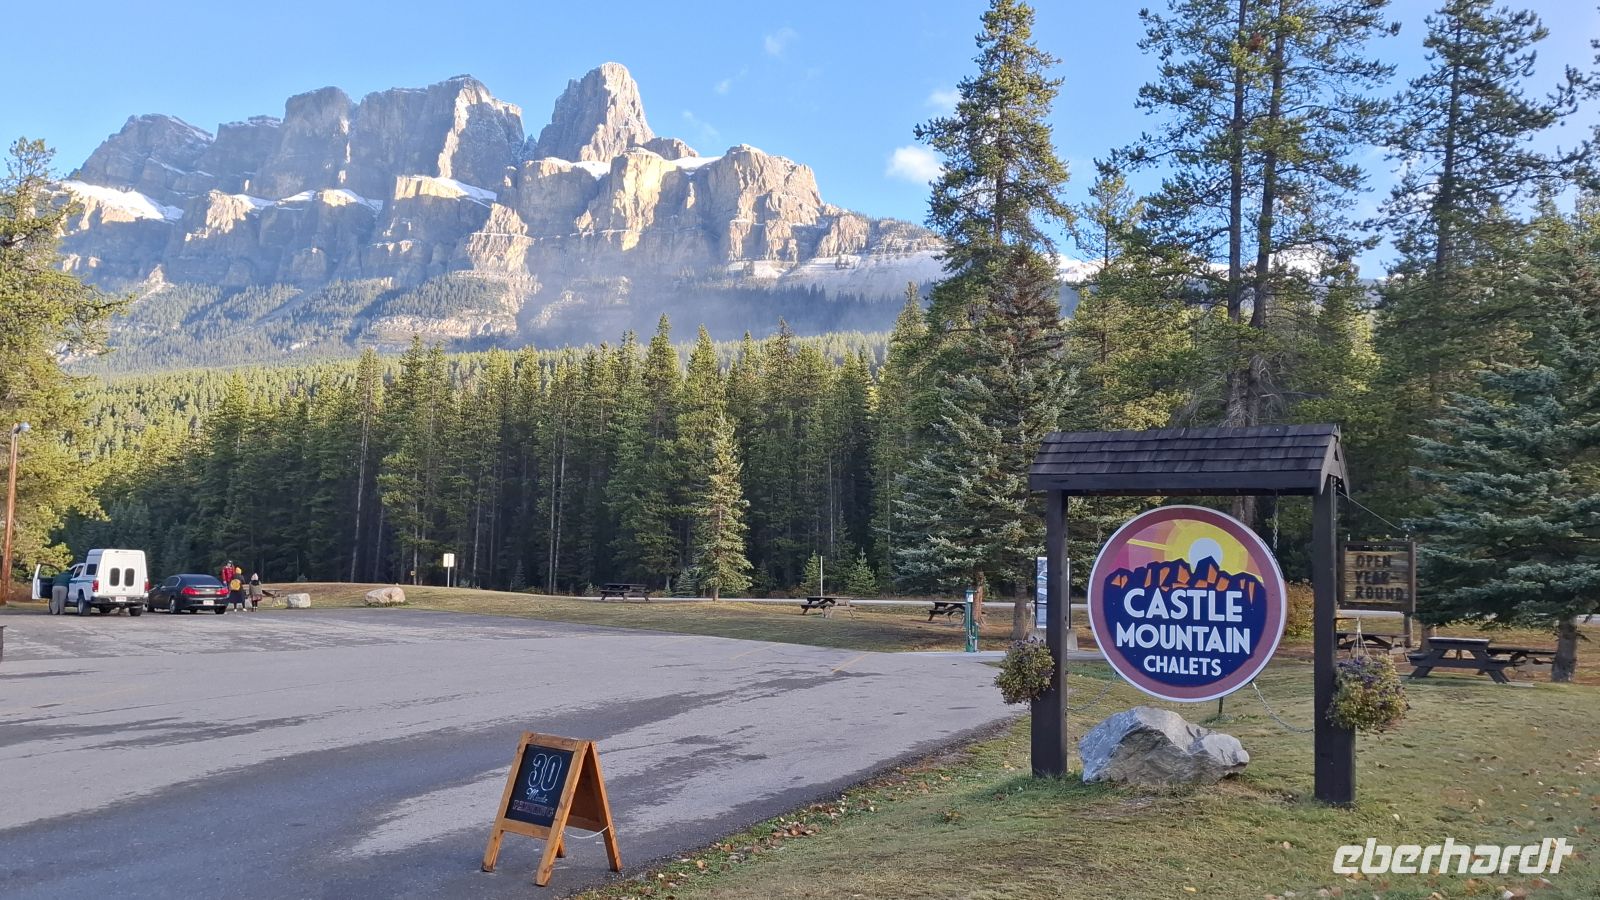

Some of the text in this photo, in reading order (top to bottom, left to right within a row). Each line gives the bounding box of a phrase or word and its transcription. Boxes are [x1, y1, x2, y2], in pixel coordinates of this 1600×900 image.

[1356, 555, 1392, 568] OPEN
[1124, 588, 1243, 622] CASTLE
[1355, 586, 1404, 600] ROUND
[1117, 622, 1250, 654] MOUNTAIN
[1143, 655, 1222, 677] CHALETS
[528, 753, 562, 791] 30
